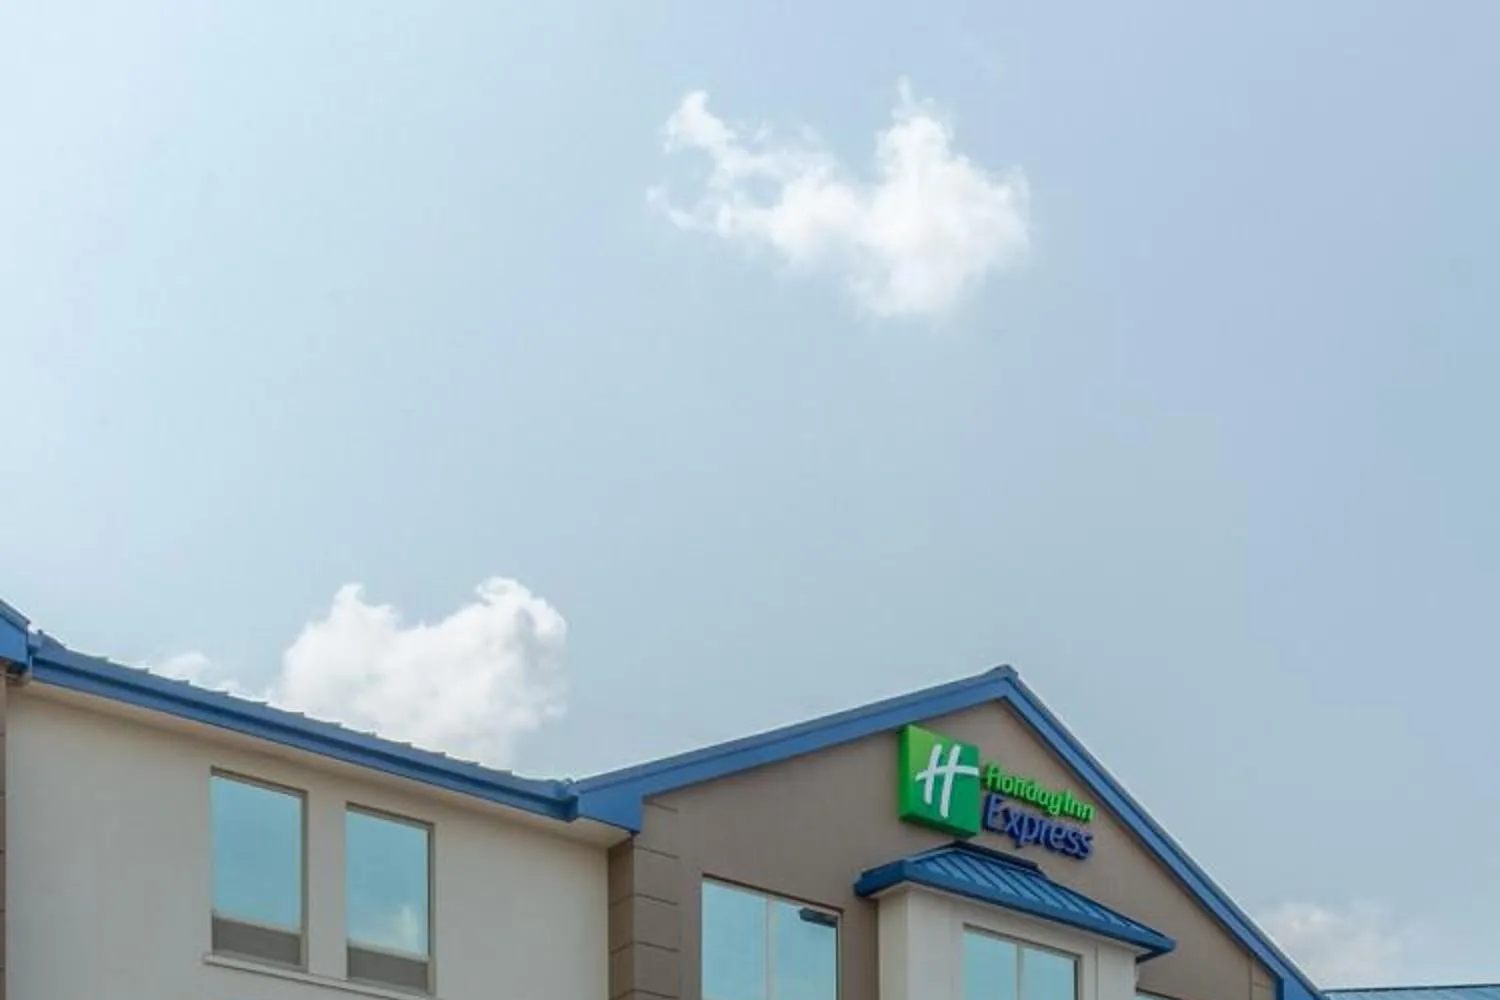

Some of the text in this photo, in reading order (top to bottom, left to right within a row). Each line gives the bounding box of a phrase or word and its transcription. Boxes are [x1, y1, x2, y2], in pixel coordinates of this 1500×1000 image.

[986, 763, 1096, 823] Holiday Inn
[984, 792, 1092, 858] Express
